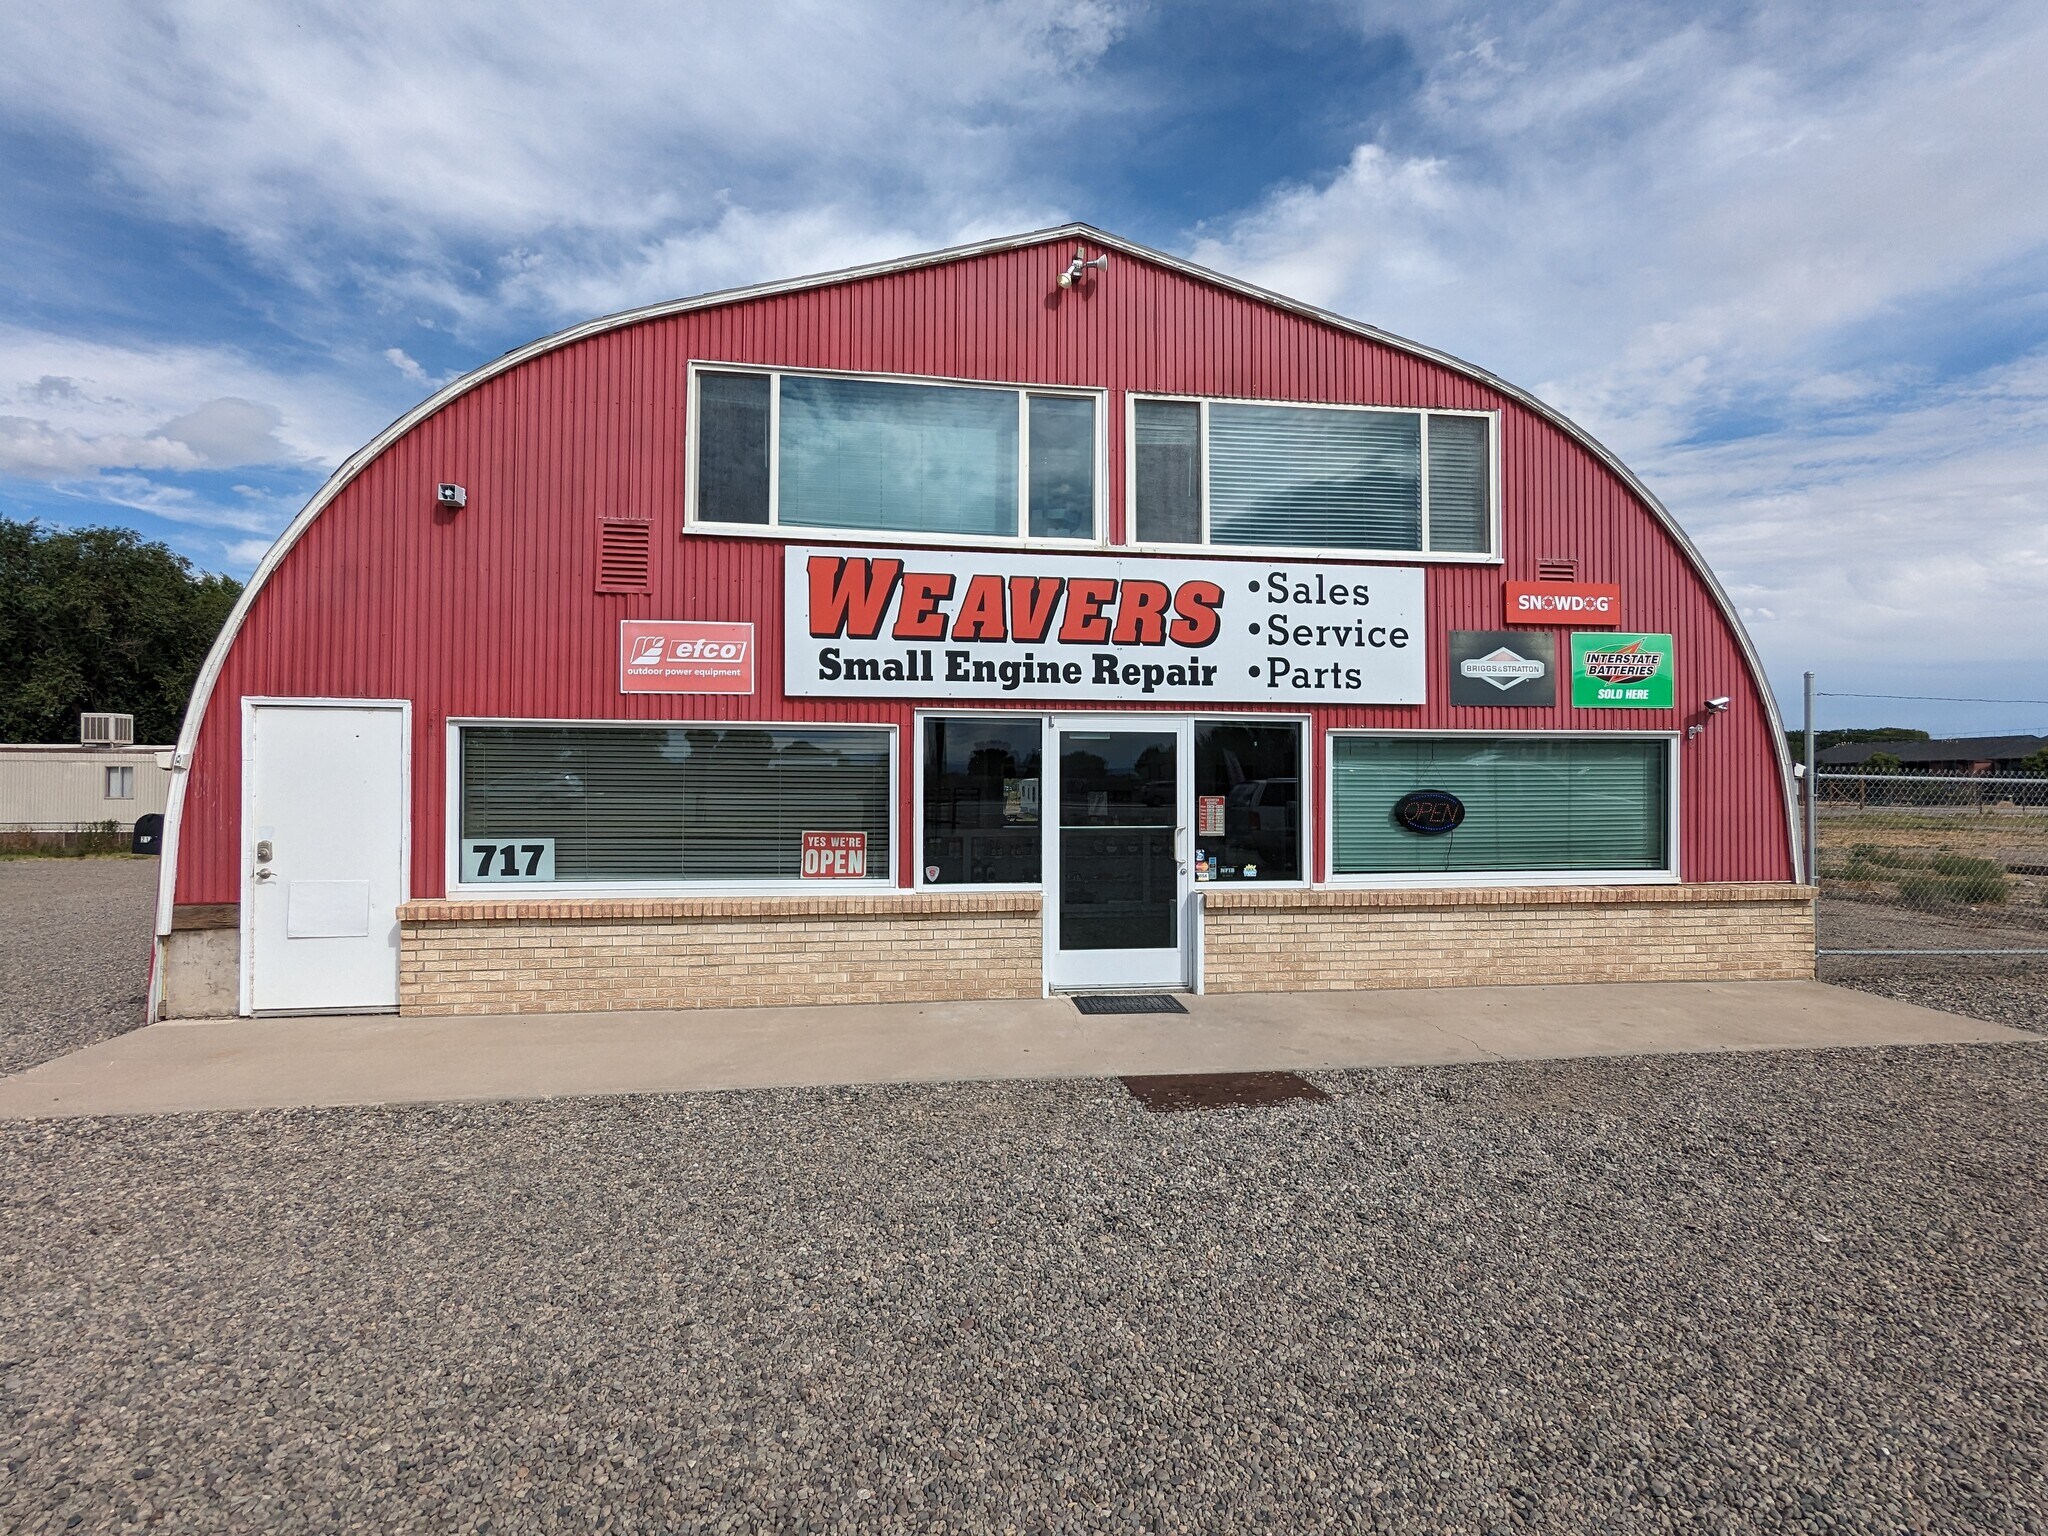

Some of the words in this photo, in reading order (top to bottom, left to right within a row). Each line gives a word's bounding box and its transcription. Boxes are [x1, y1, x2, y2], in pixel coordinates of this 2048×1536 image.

[1267, 572, 1370, 606] Sales
[806, 556, 1226, 648] WEAVERS
[1518, 594, 1609, 612] SNOWDOG
[1267, 613, 1409, 648] Service
[676, 639, 737, 659] efco
[1586, 653, 1660, 665] INTERSTATE
[627, 667, 663, 676] outdoor
[665, 668, 692, 677] power
[694, 667, 741, 678] equipment
[818, 647, 934, 682] Small
[945, 650, 1083, 691] Engine
[1092, 653, 1218, 694] Repair
[1266, 656, 1362, 690] Parts
[1588, 665, 1654, 676] BATTERIES
[1597, 688, 1624, 700] SOLD
[1625, 688, 1650, 700] HERE
[1404, 801, 1460, 823] OPEN
[807, 836, 827, 847] YES
[830, 836, 862, 848] WE'RE
[472, 844, 545, 877] 717
[804, 848, 863, 875] OPEN
